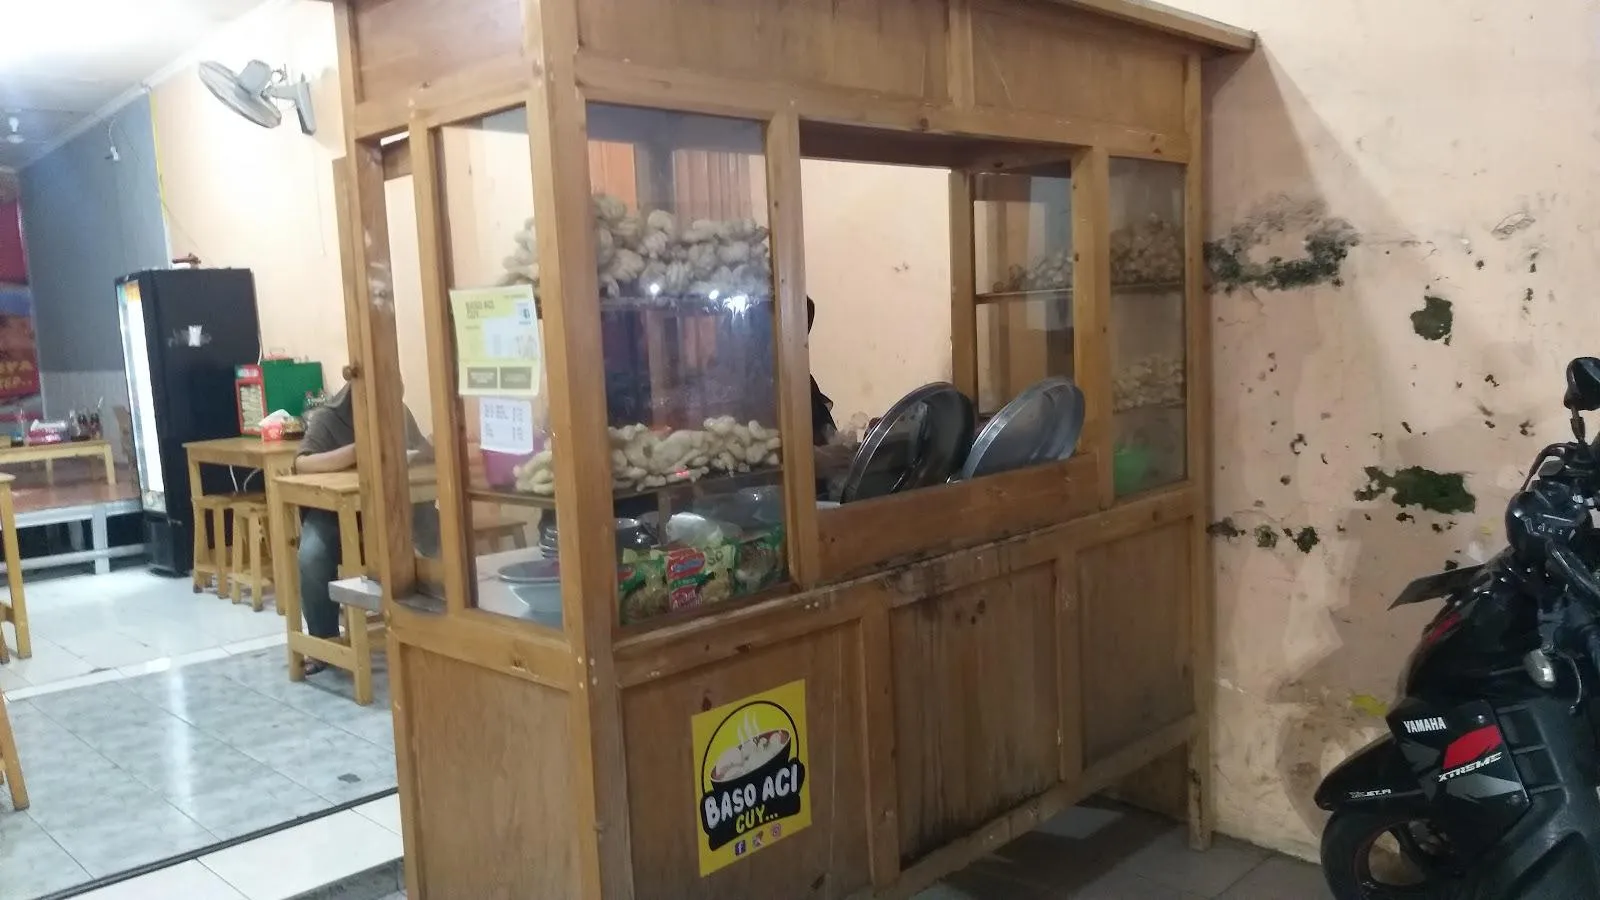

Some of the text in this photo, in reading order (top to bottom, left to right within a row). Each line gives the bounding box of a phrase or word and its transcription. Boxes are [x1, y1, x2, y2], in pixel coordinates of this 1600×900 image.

[1403, 716, 1447, 734] YAMAHA
[704, 764, 798, 829] BASO ACI
